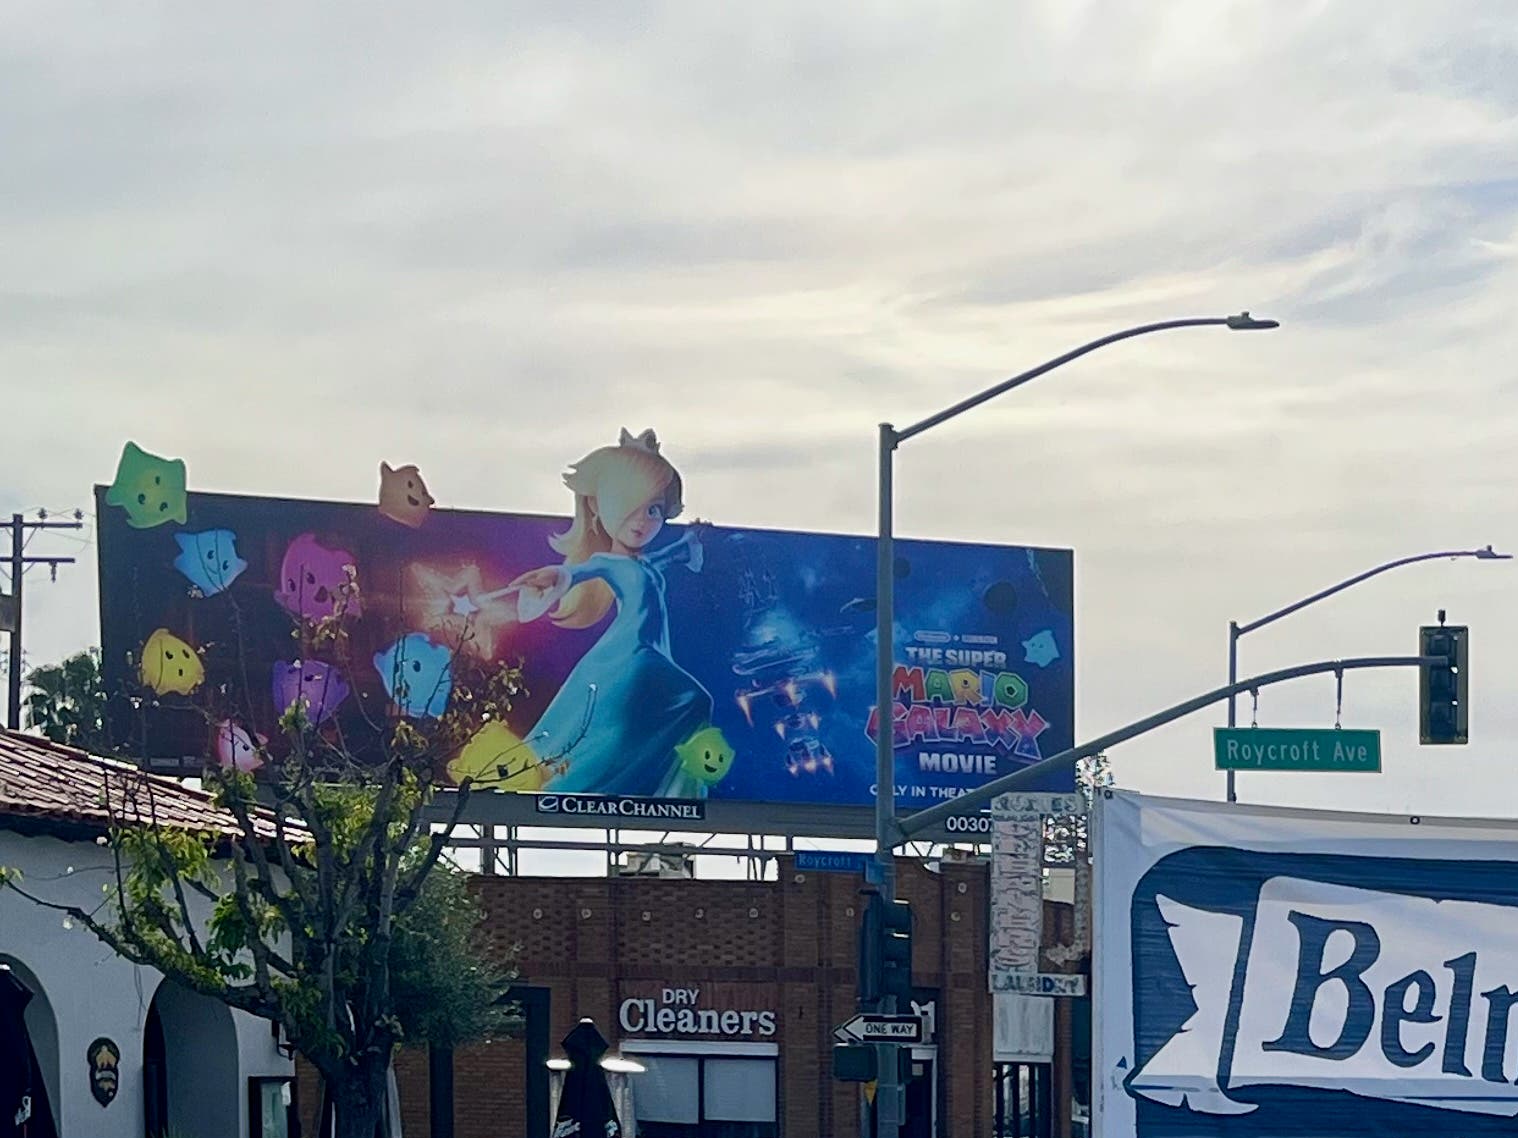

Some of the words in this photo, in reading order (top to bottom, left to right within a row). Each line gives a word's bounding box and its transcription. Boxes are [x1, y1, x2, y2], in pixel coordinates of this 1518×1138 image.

[904, 646, 943, 665] THE
[944, 648, 1007, 669] SUPER
[892, 665, 1028, 710] MARIO
[864, 702, 1050, 761] GALAXY
[1227, 739, 1320, 765] Roycroft
[1333, 740, 1368, 762] Ave
[919, 752, 998, 776] MOVIE
[869, 783, 908, 797] OLY
[911, 785, 927, 797] IN
[946, 816, 993, 833] 0030
[662, 988, 700, 1005] DRY
[619, 998, 777, 1036] Cleaners
[865, 1023, 888, 1034] ONE
[891, 1024, 914, 1034] WAY
